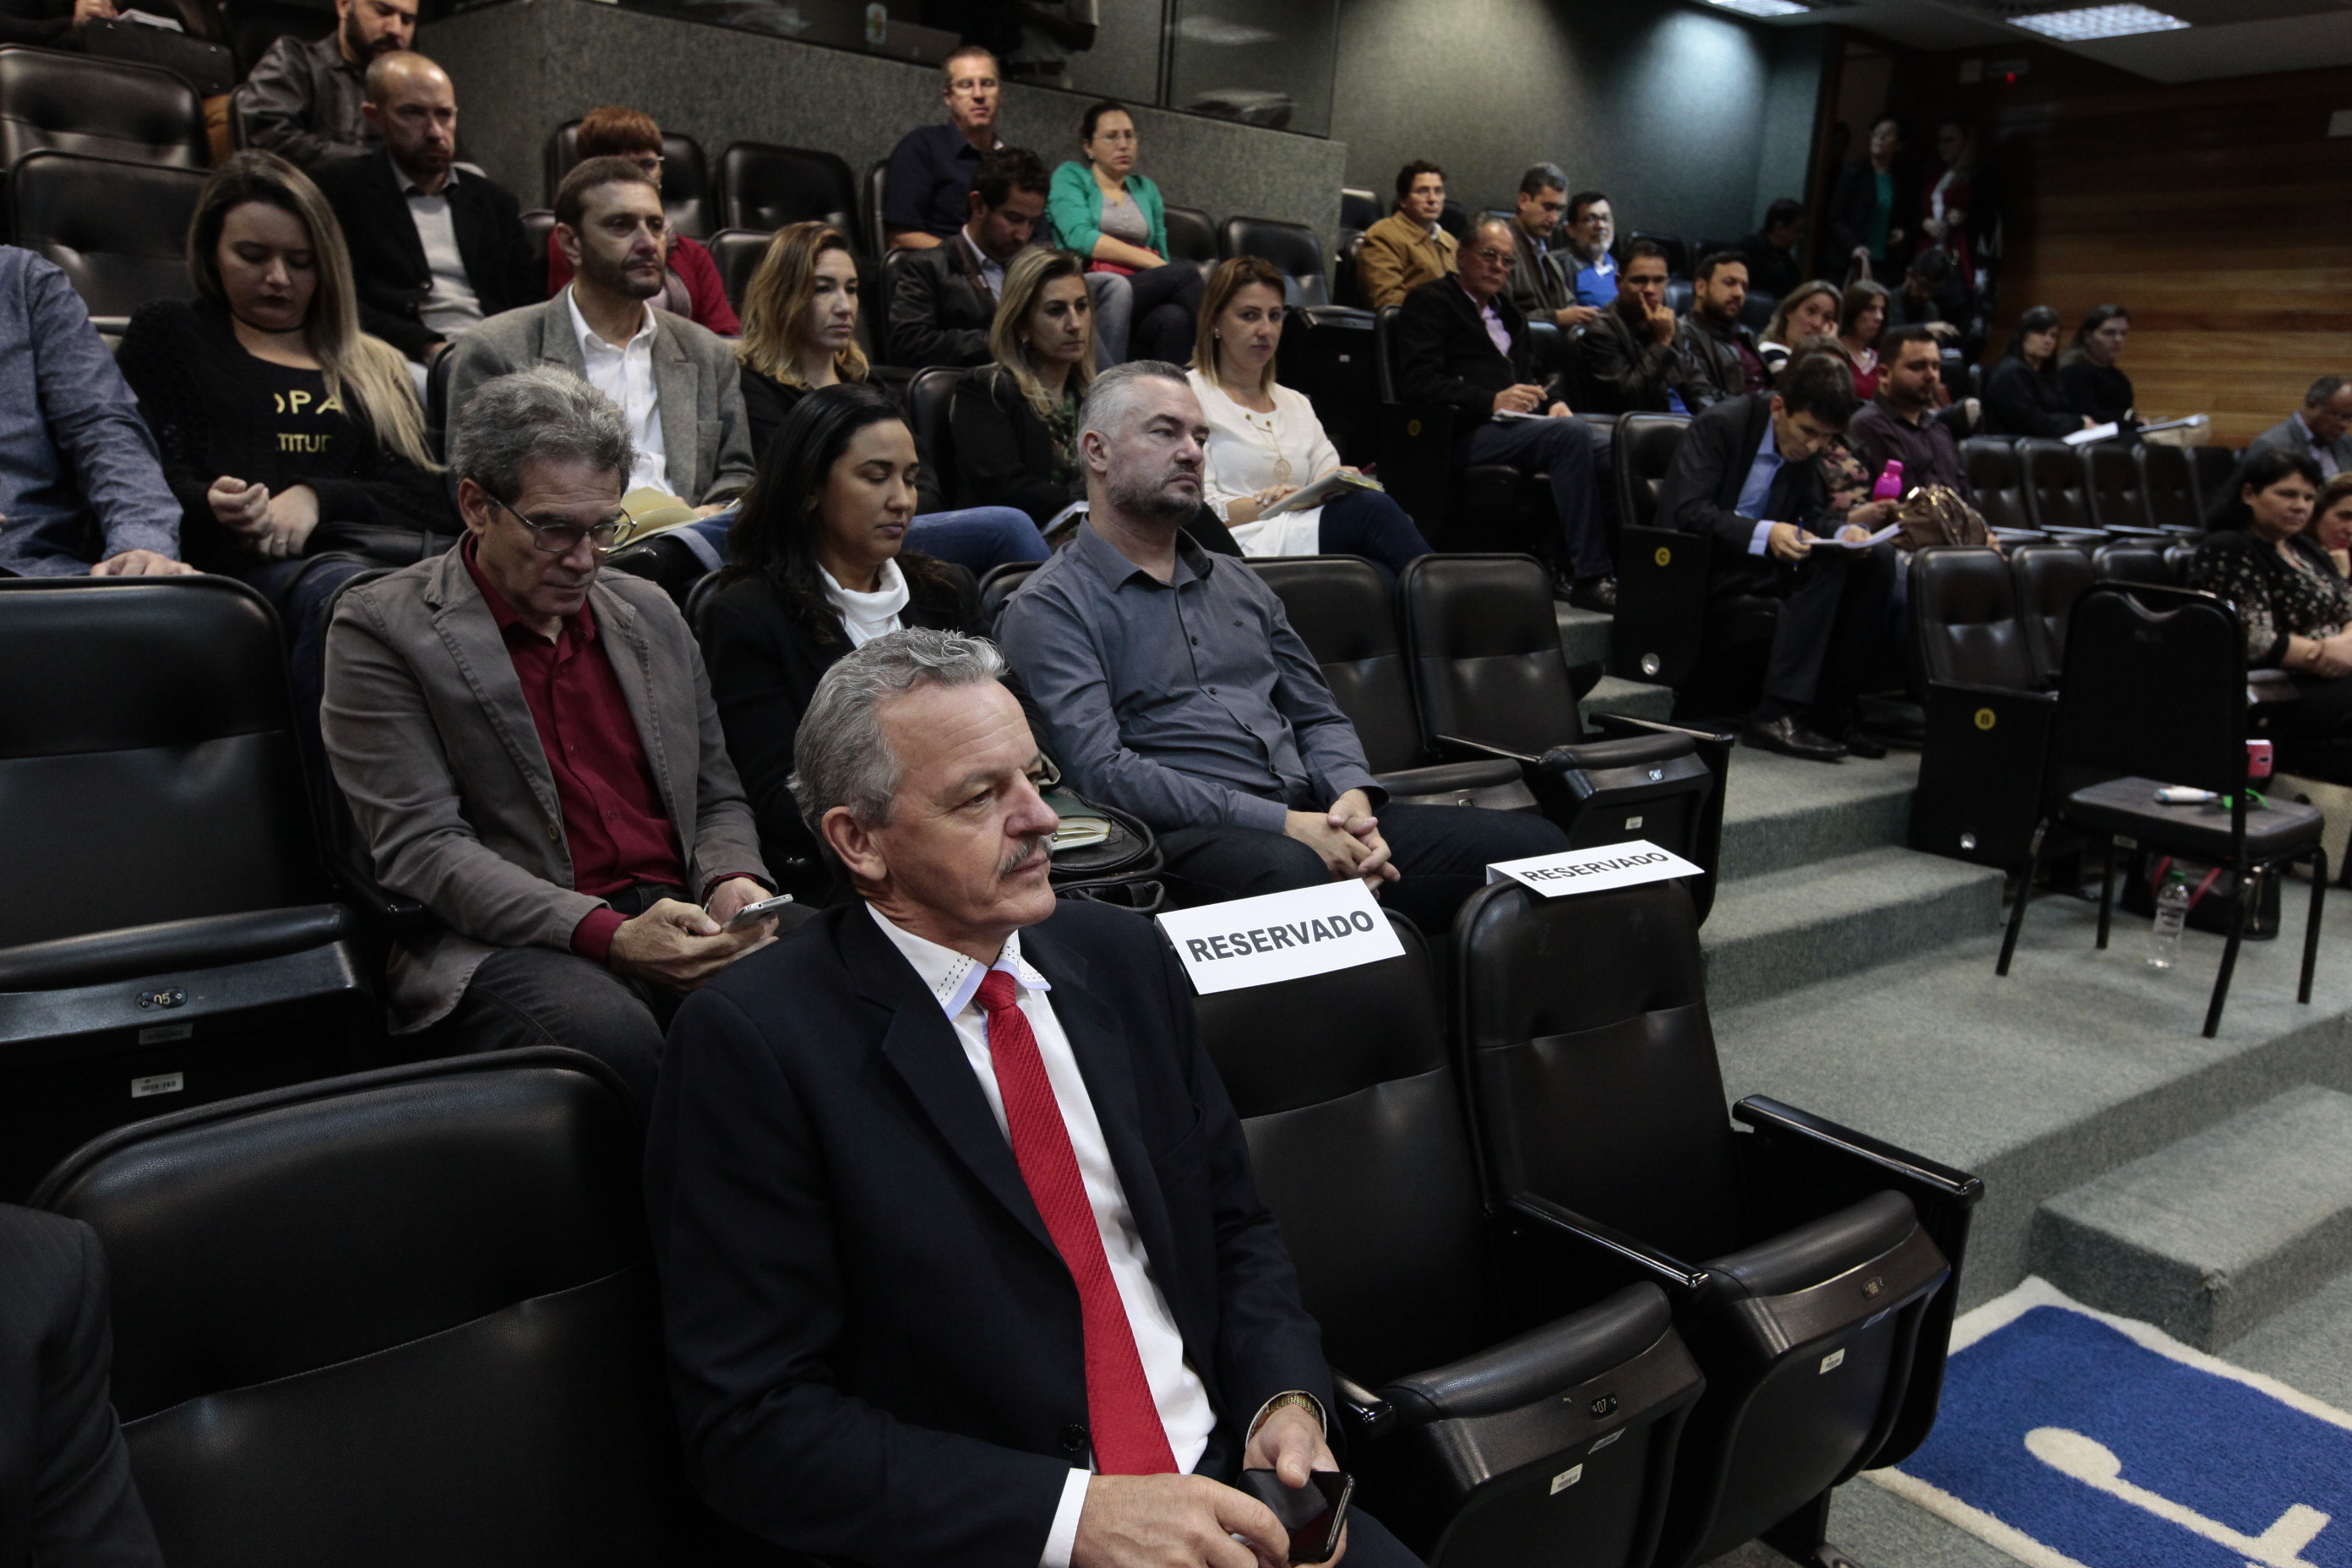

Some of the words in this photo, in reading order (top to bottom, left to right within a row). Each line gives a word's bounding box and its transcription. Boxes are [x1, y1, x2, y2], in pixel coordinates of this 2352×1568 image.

[1520, 852, 1669, 882] RESERVADO
[1185, 910, 1375, 962] RESERVADO
[1597, 1398, 1607, 1413] 07
